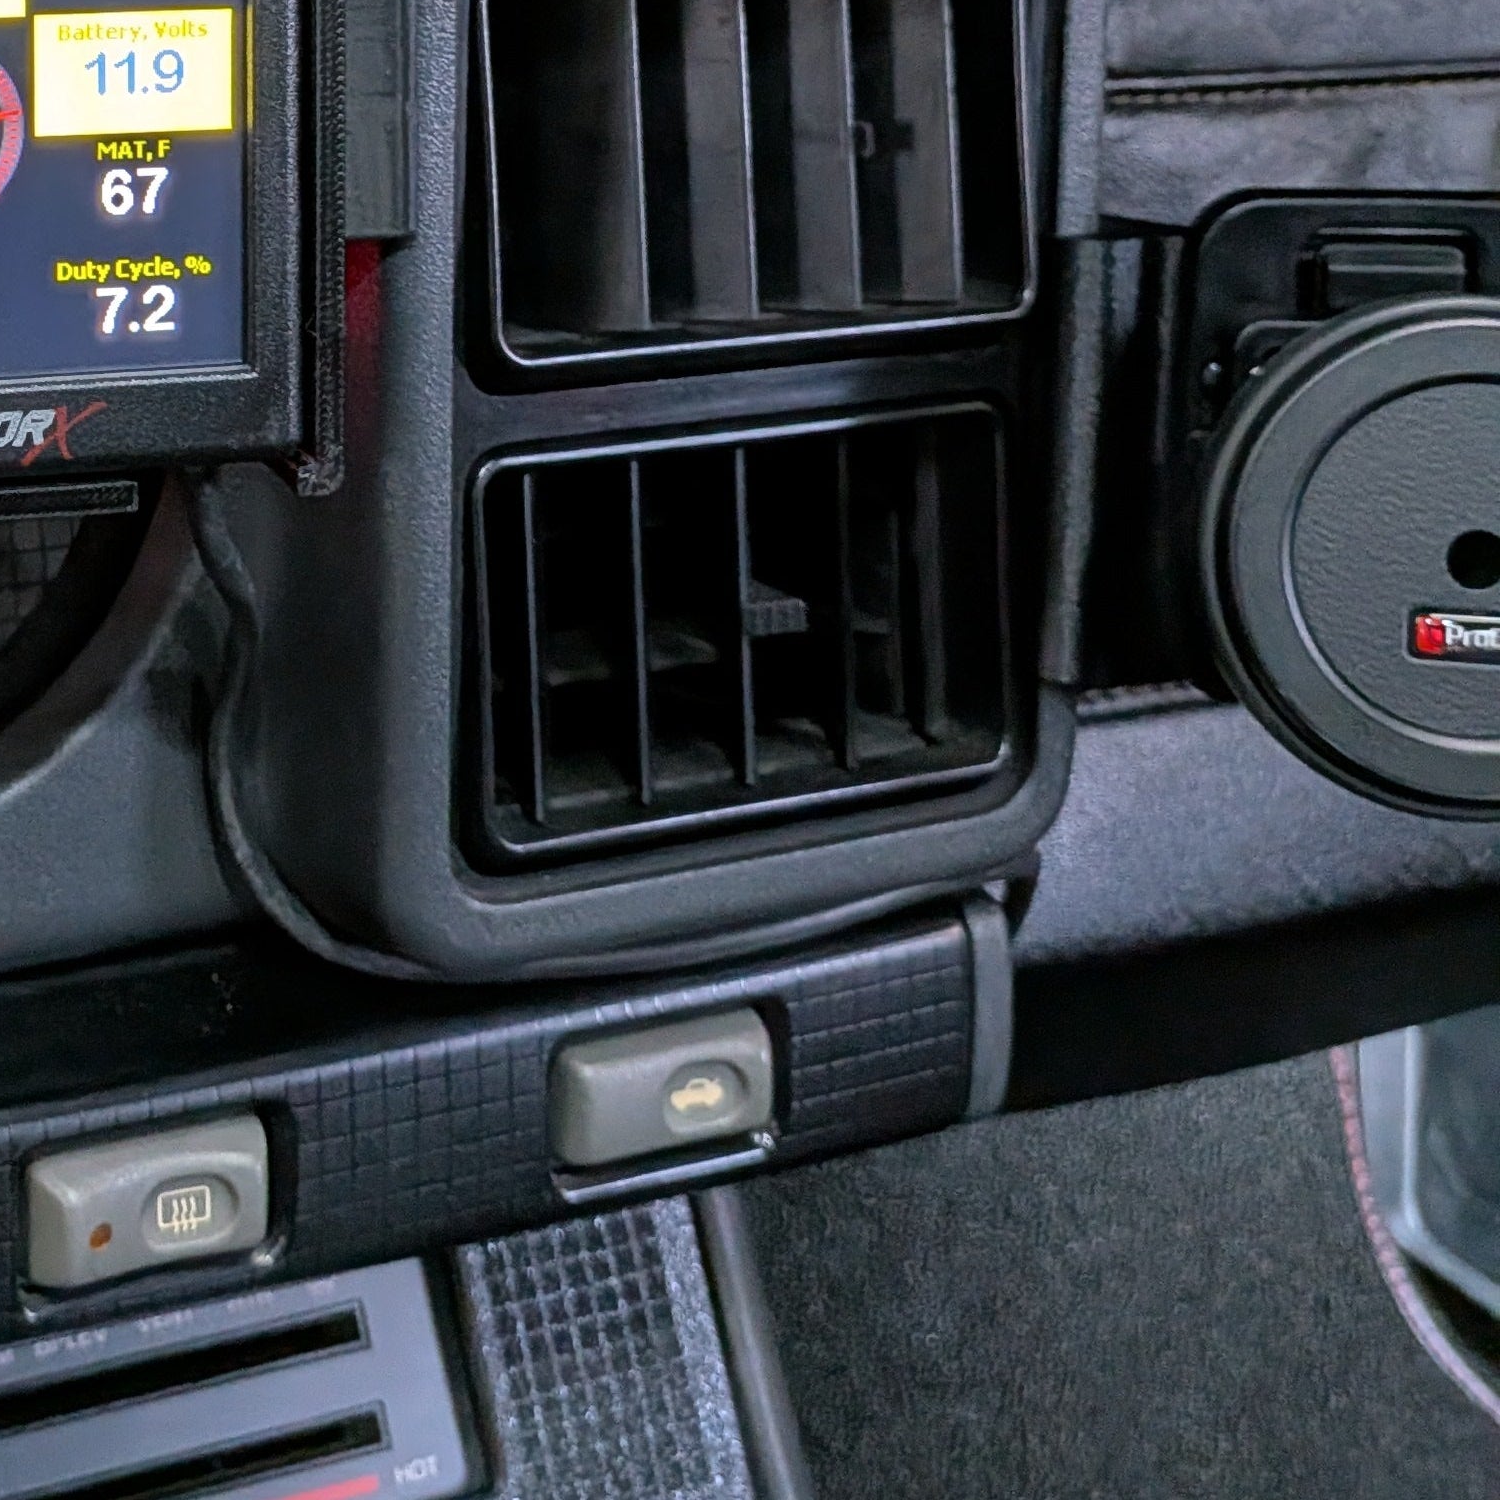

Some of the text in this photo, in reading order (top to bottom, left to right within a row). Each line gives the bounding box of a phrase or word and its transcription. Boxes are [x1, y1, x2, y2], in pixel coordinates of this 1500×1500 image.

[58, 20, 208, 42] Battery, Volts
[85, 49, 184, 95] 11.9
[97, 140, 171, 162] MAT, F
[101, 167, 169, 216] 67
[56, 255, 211, 283] Duty Cycle, %
[96, 284, 175, 335] 7.2
